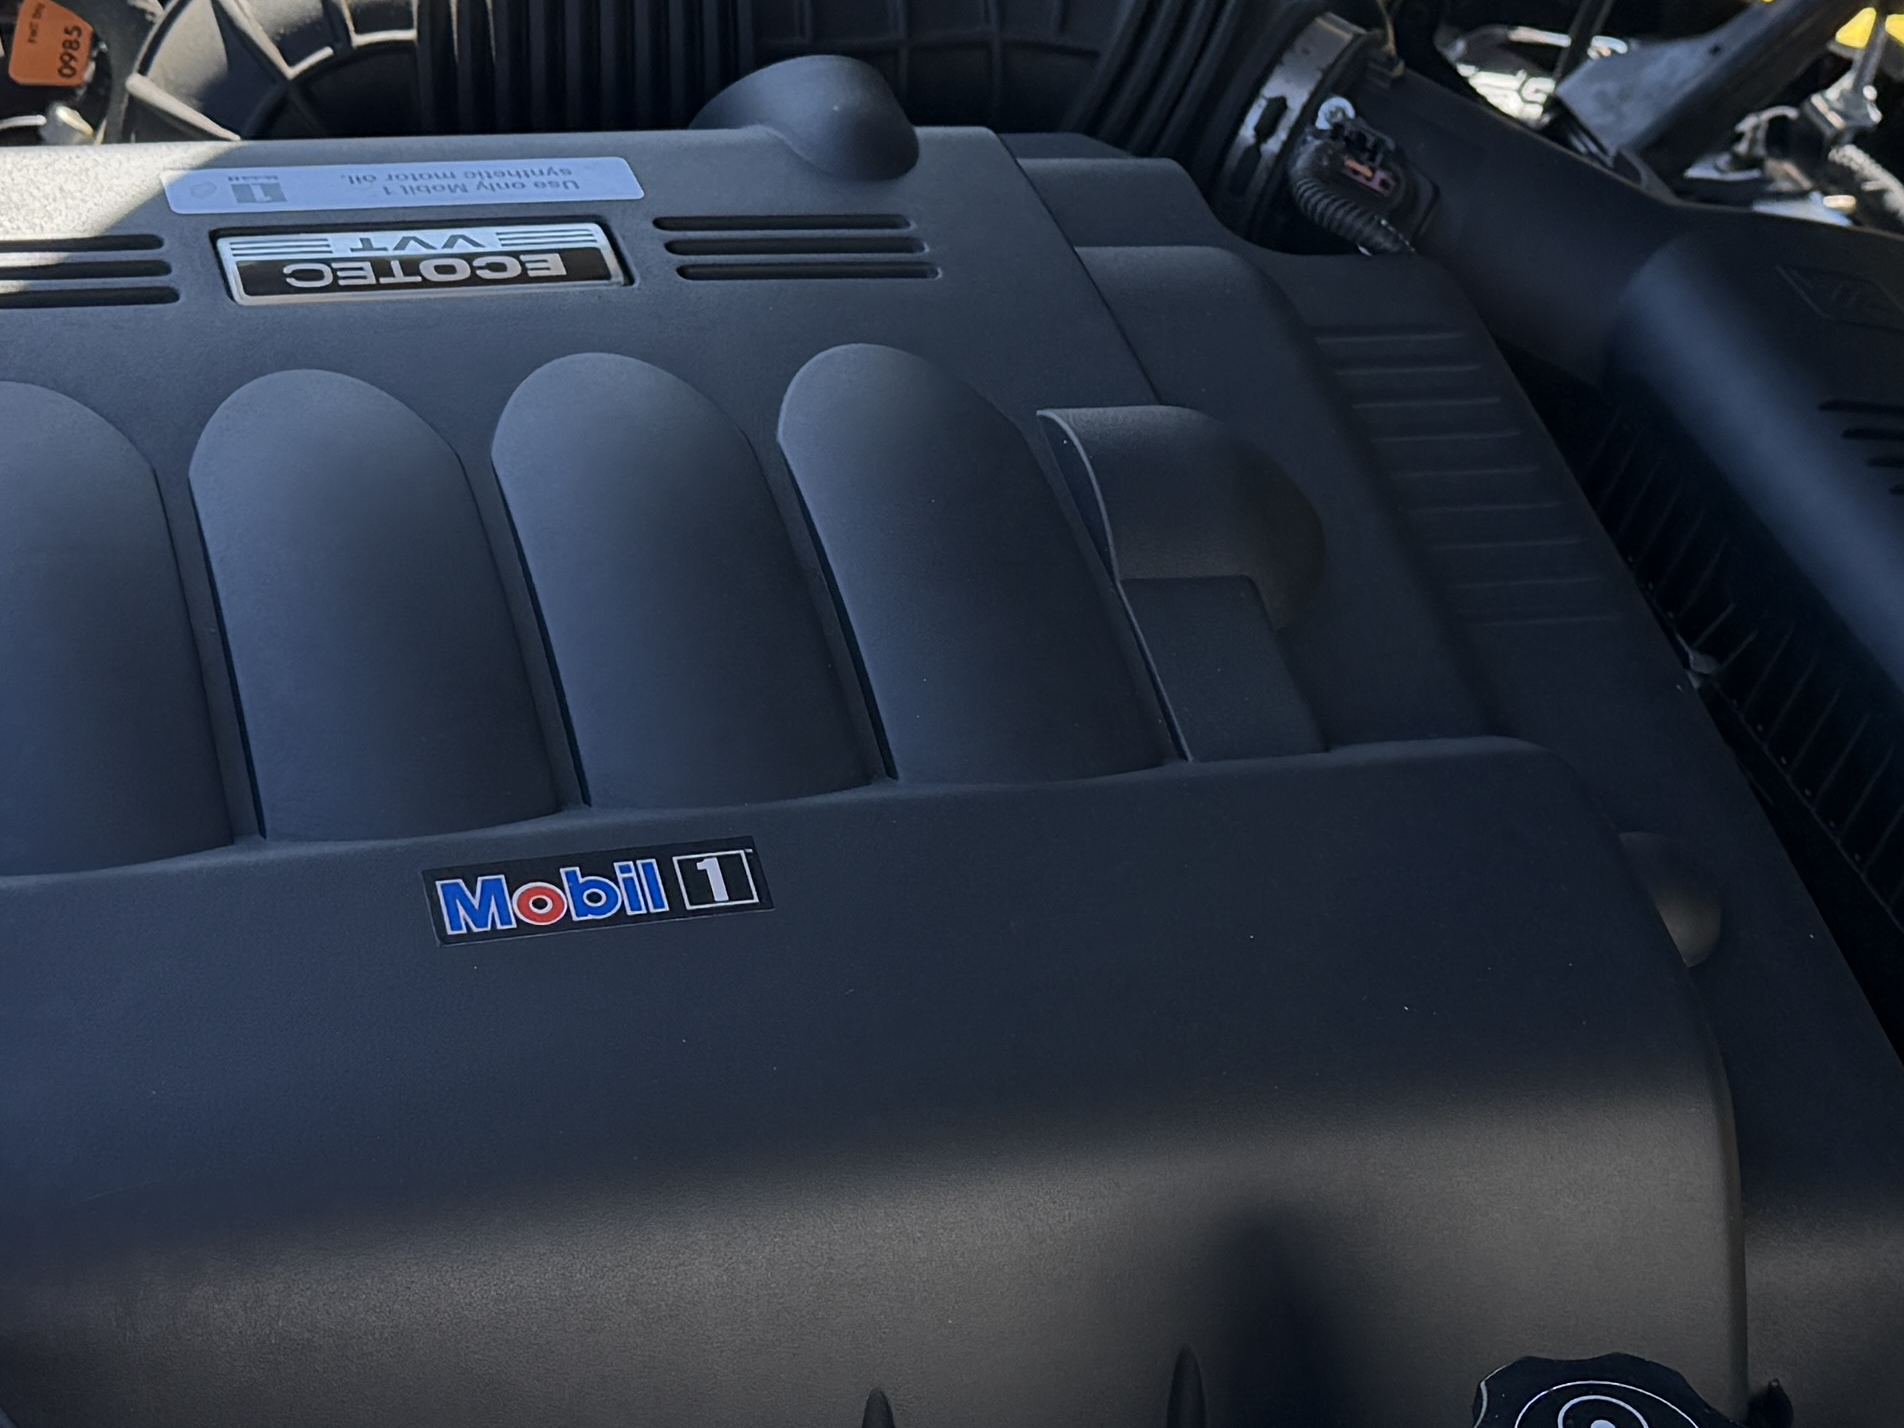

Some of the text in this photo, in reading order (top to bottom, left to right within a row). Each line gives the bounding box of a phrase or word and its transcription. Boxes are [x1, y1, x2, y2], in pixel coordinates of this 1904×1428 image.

[57, 26, 82, 79] 0985
[340, 166, 573, 185] synthetic motor oil.
[382, 179, 580, 196] Use only Mobil 1
[349, 234, 486, 252] VVT
[283, 253, 567, 288] ECOTEC
[435, 858, 670, 935] Mobil
